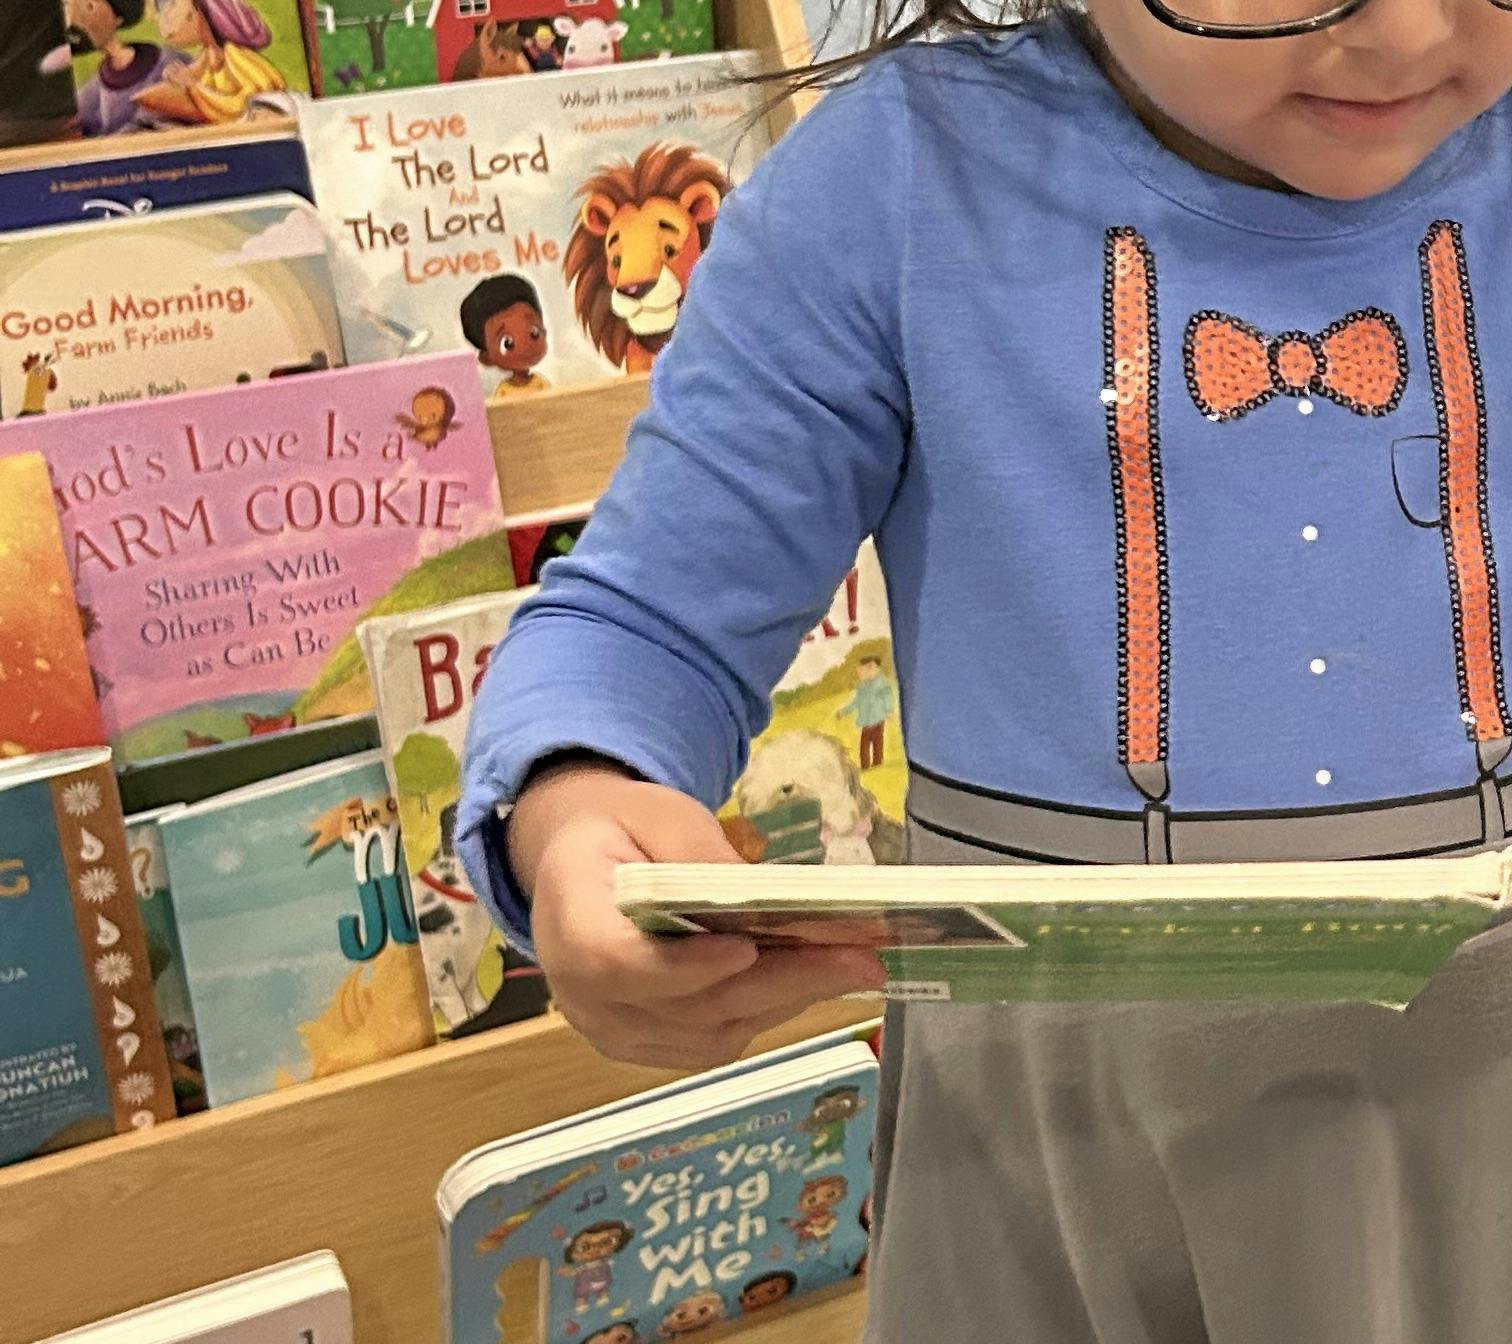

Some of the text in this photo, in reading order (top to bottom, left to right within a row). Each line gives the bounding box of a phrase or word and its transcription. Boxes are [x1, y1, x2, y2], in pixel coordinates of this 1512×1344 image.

[346, 111, 467, 152] I Love
[665, 103, 697, 122] with
[391, 134, 550, 191] The Lord
[448, 184, 480, 207] And
[343, 195, 506, 253] The Lord
[401, 234, 561, 287] Loves Me
[1, 282, 253, 339] Good Morning,
[54, 318, 214, 361] Farm Friends
[185, 423, 299, 474] Love
[325, 409, 361, 462] Is
[381, 431, 408, 462] a
[69, 476, 468, 582] ARM COOKIE
[144, 550, 341, 610] Sharing With
[140, 584, 360, 646] Others Is Sweet
[185, 630, 330, 678] as Can Be
[0, 1056, 76, 1086] UNCAN
[0, 1067, 90, 1102] ONATIUH
[638, 1207, 767, 1272] with
[650, 1250, 752, 1306] Me
